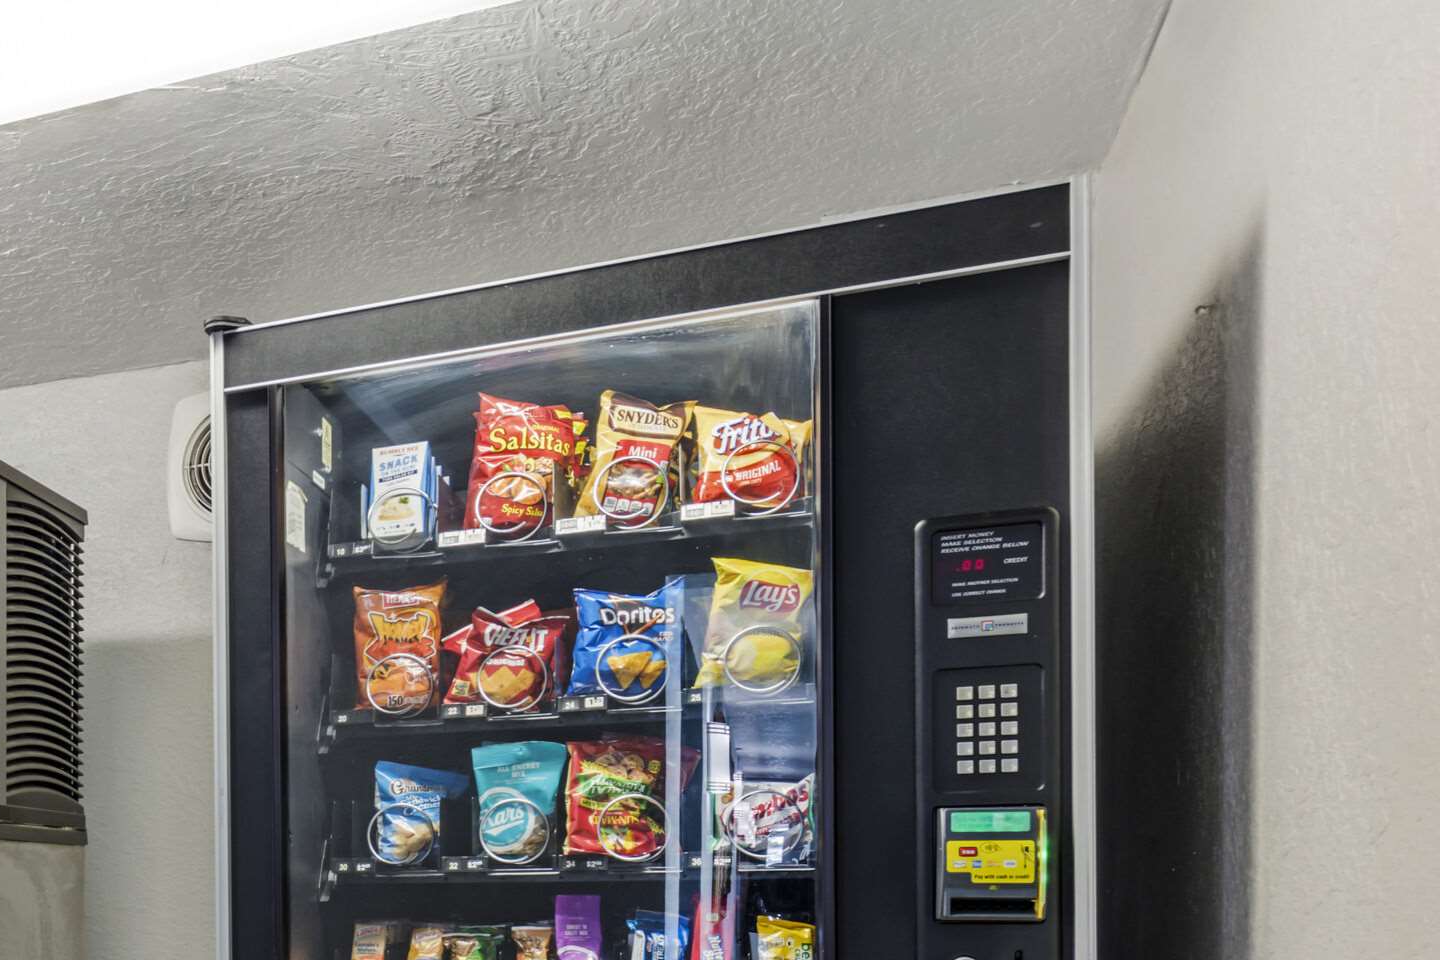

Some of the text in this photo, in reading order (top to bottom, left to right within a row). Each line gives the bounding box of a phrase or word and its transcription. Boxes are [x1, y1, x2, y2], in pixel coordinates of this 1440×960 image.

[616, 408, 679, 430] SNYDER'S
[489, 427, 570, 456] Salsitas
[711, 415, 783, 454] Frito
[628, 445, 658, 459] Mini
[379, 454, 418, 472] SNACK
[502, 503, 525, 516] Spicy
[940, 531, 994, 541] INSERT MONEY
[962, 537, 1003, 545] SELECTION
[940, 546, 970, 554] RECEIVE
[971, 543, 1001, 551] CHANGE
[1003, 556, 1029, 564] CREDIT
[742, 580, 798, 612] Lay's
[600, 607, 675, 625] Doritos
[388, 696, 403, 706] 150
